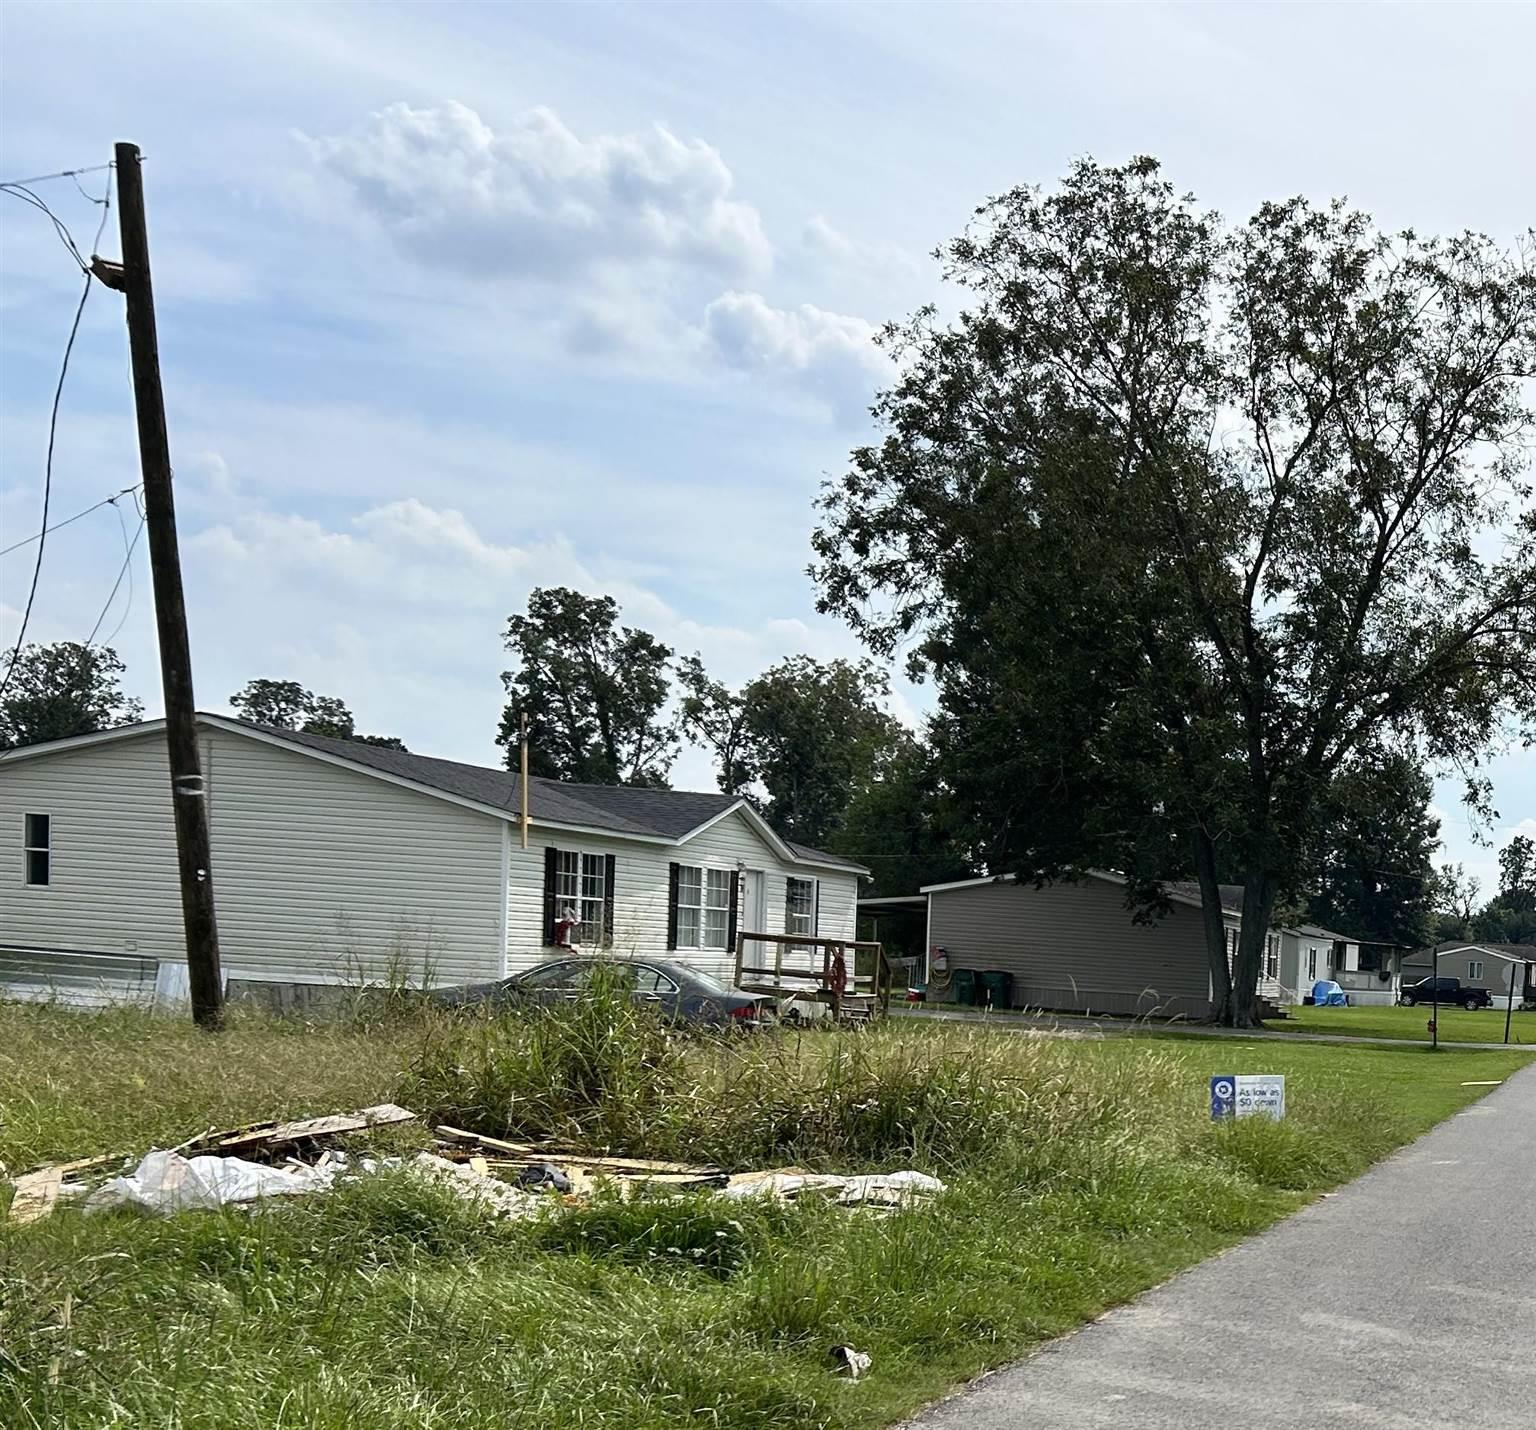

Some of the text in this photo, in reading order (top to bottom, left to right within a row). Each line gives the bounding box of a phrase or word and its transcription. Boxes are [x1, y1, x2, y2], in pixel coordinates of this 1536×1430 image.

[1239, 1088, 1280, 1097] As low as
